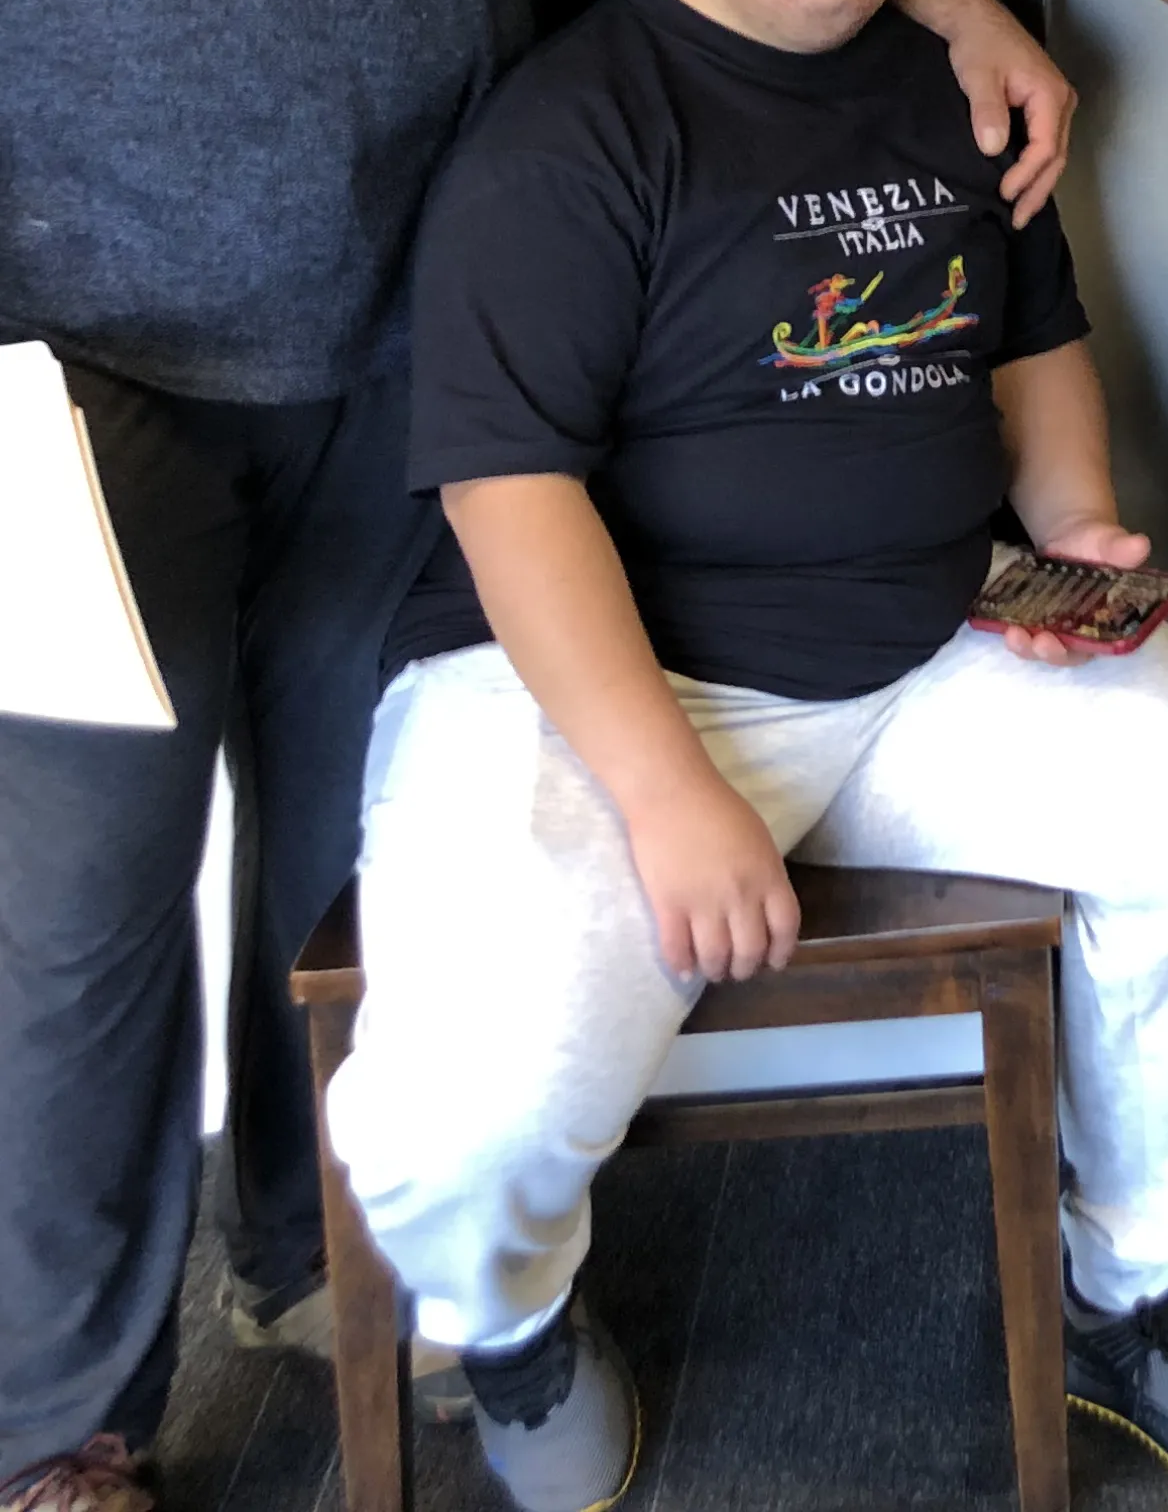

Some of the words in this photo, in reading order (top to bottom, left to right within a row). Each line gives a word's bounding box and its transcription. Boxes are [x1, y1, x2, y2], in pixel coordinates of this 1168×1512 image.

[778, 177, 957, 228] VENEZIA
[838, 220, 925, 257] ITALIA
[780, 380, 822, 402] LA
[838, 363, 971, 398] GONDOLA
